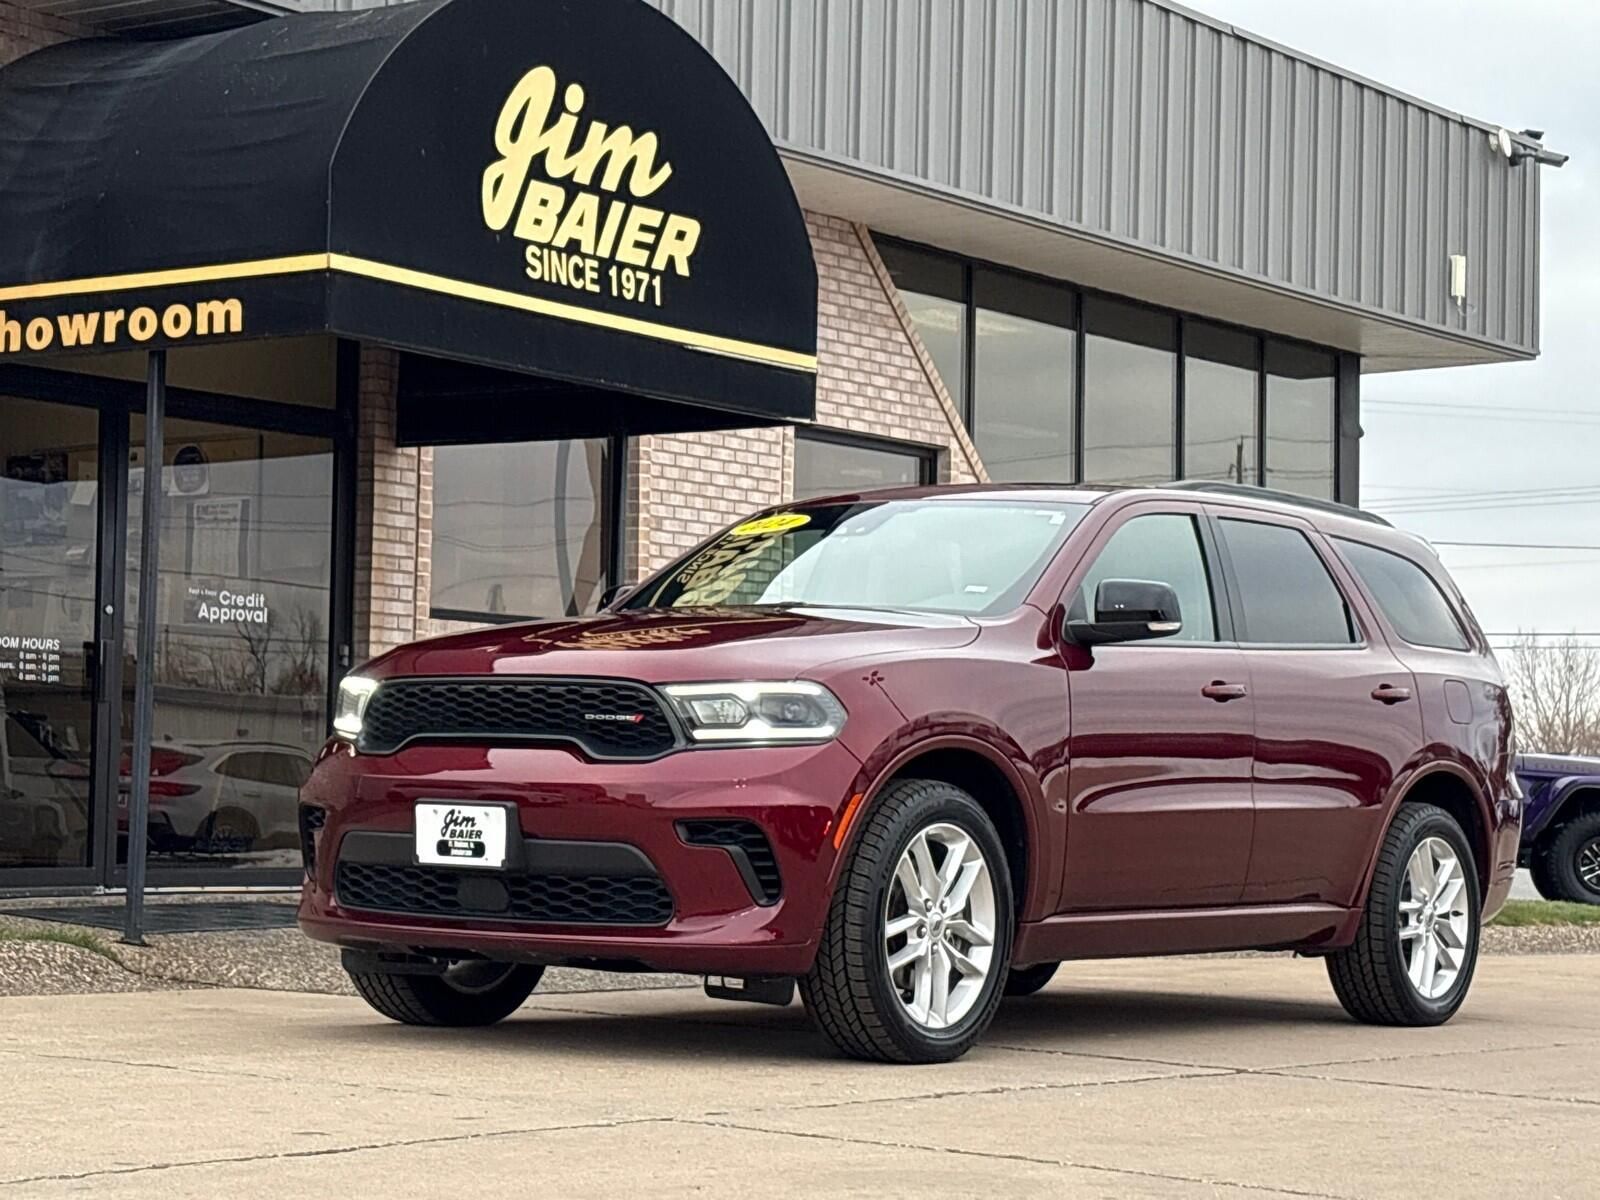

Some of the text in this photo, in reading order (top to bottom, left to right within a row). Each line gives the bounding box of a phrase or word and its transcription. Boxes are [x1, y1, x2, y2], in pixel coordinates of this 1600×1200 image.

[482, 65, 673, 230] Jim
[513, 179, 701, 277] BAIER
[525, 245, 662, 306] SINCE 1971
[0, 298, 243, 353] howroom
[219, 590, 265, 608] Credit
[198, 602, 268, 624] Approval
[0, 636, 60, 650] OM HOURS
[584, 713, 636, 721] DODGE
[441, 808, 476, 838] Jim
[449, 829, 483, 840] BAIER
